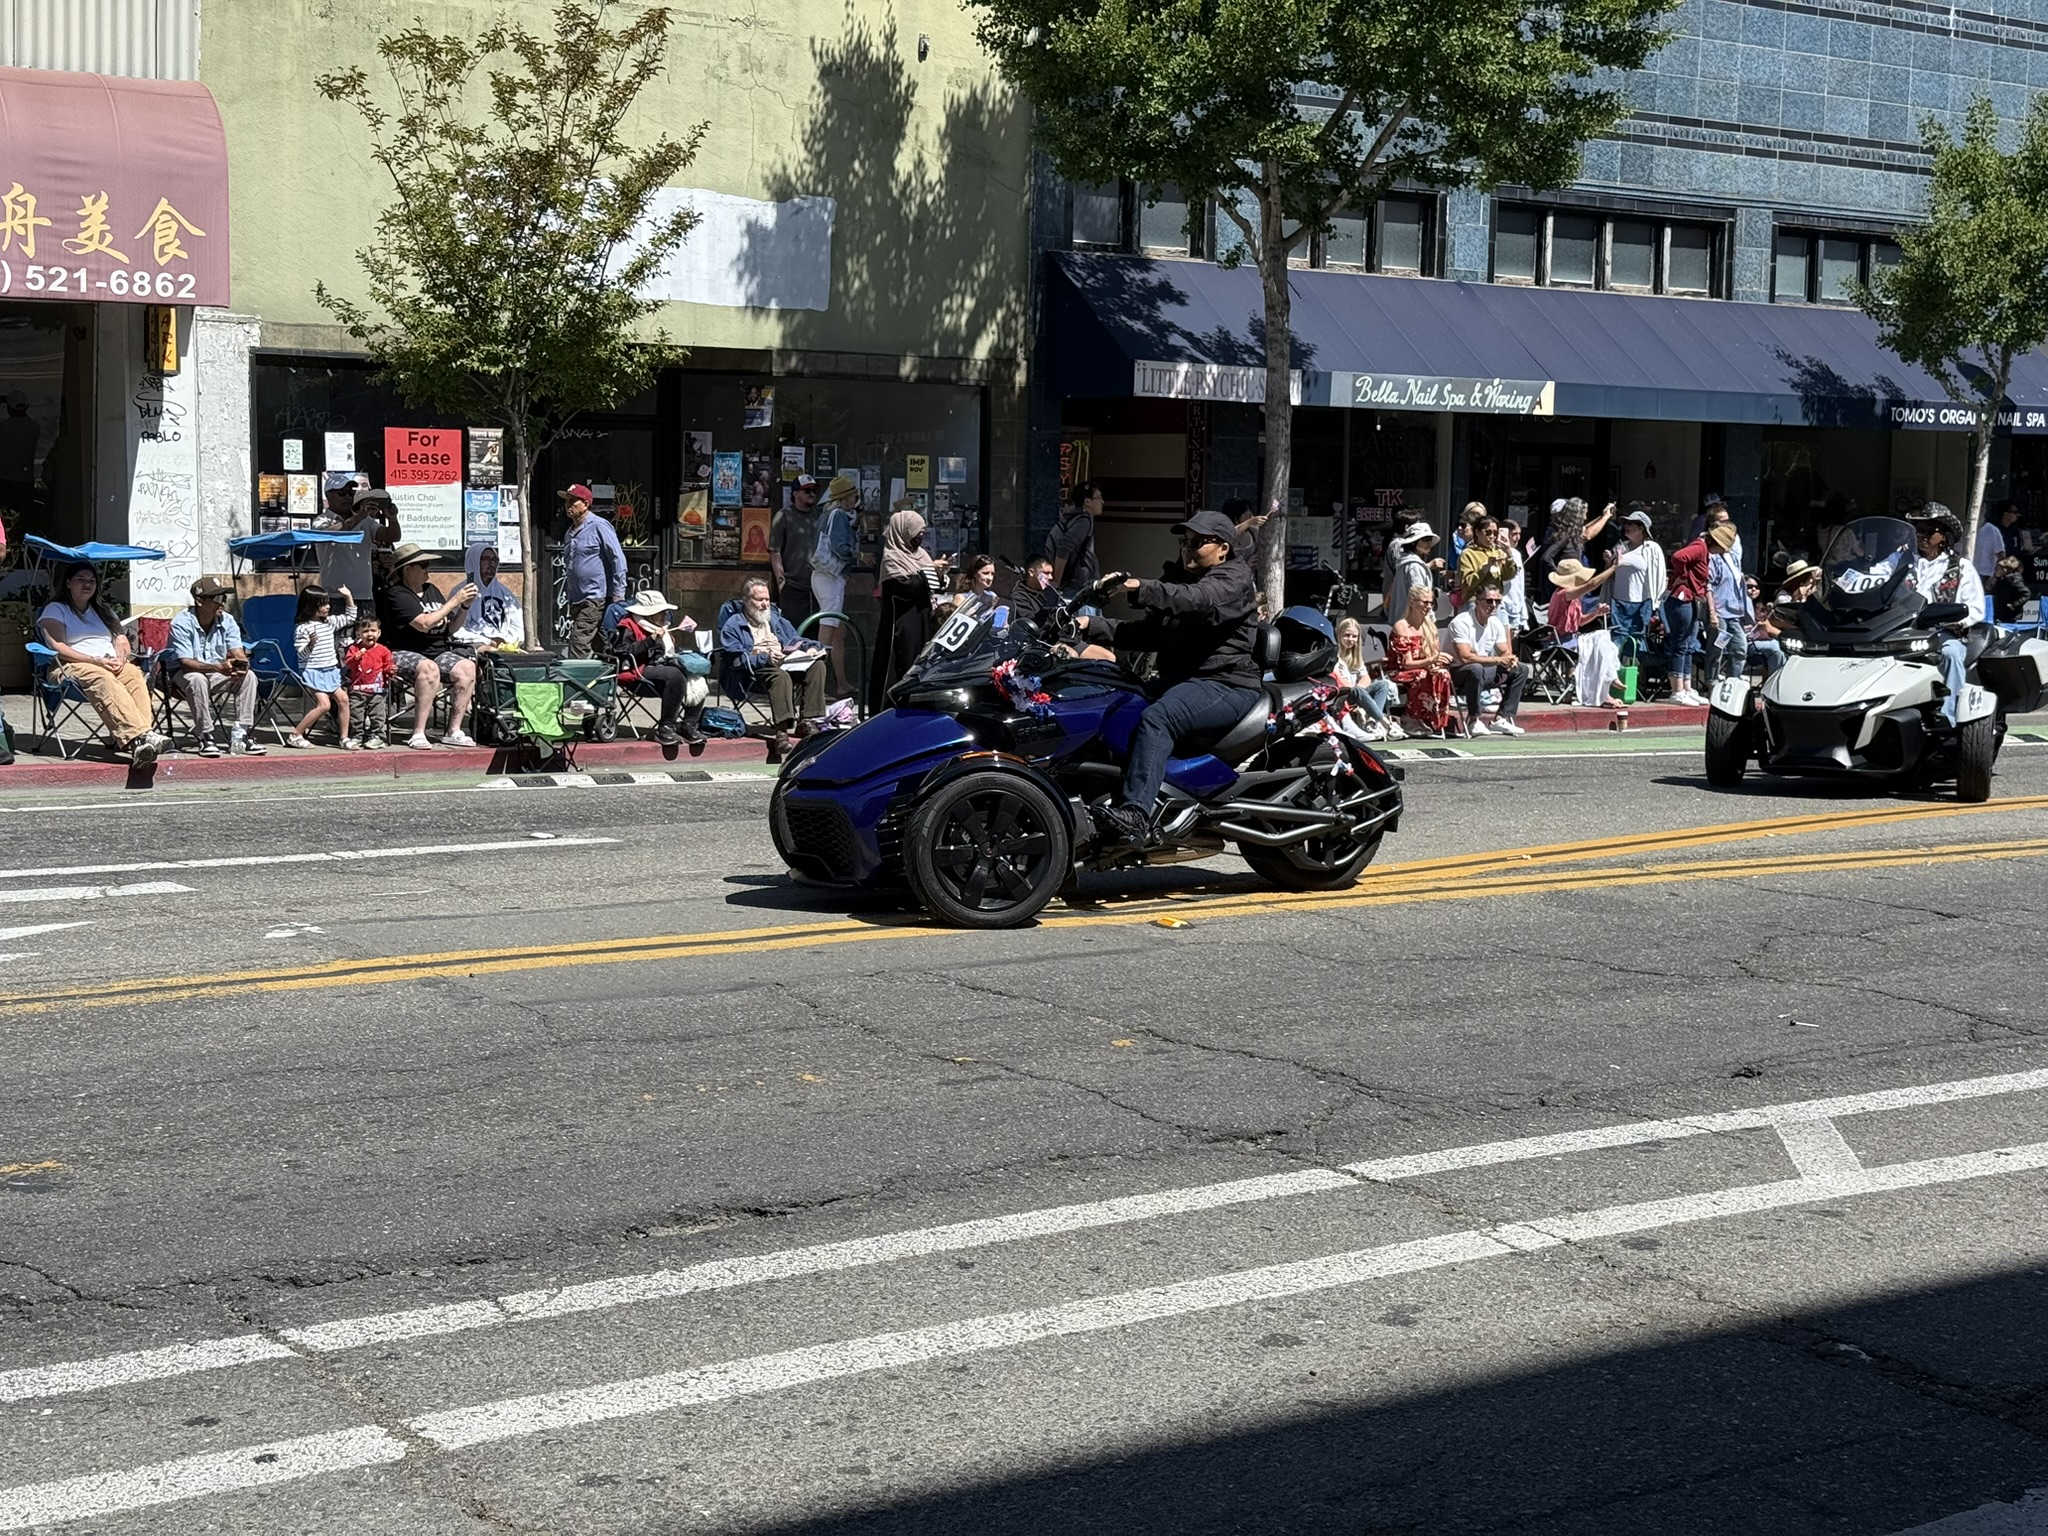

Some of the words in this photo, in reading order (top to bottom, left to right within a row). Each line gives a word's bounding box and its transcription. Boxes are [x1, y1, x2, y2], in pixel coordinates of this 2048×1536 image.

[25, 265, 197, 299] 521-6862
[1141, 367, 1191, 396] LITTLE
[1194, 370, 1255, 400] PSYCHIC
[1355, 376, 1399, 403] Bella
[1400, 378, 1437, 406] Nail
[1440, 383, 1466, 410] Spa
[1470, 382, 1482, 407] &
[1484, 384, 1534, 414] Waxing
[1890, 407, 1935, 424] TOMO'S
[1997, 412, 2022, 427] NAIL
[2025, 412, 2045, 428] SPA
[408, 431, 440, 447] For
[396, 449, 451, 465] Lease
[910, 458, 926, 466] IMP
[390, 469, 458, 481] 415.395.7262
[391, 493, 415, 501] Justin
[417, 493, 437, 501] Choi
[406, 514, 452, 522] Badstubner
[448, 538, 460, 546] JLL
[2036, 571, 2045, 581] 10
